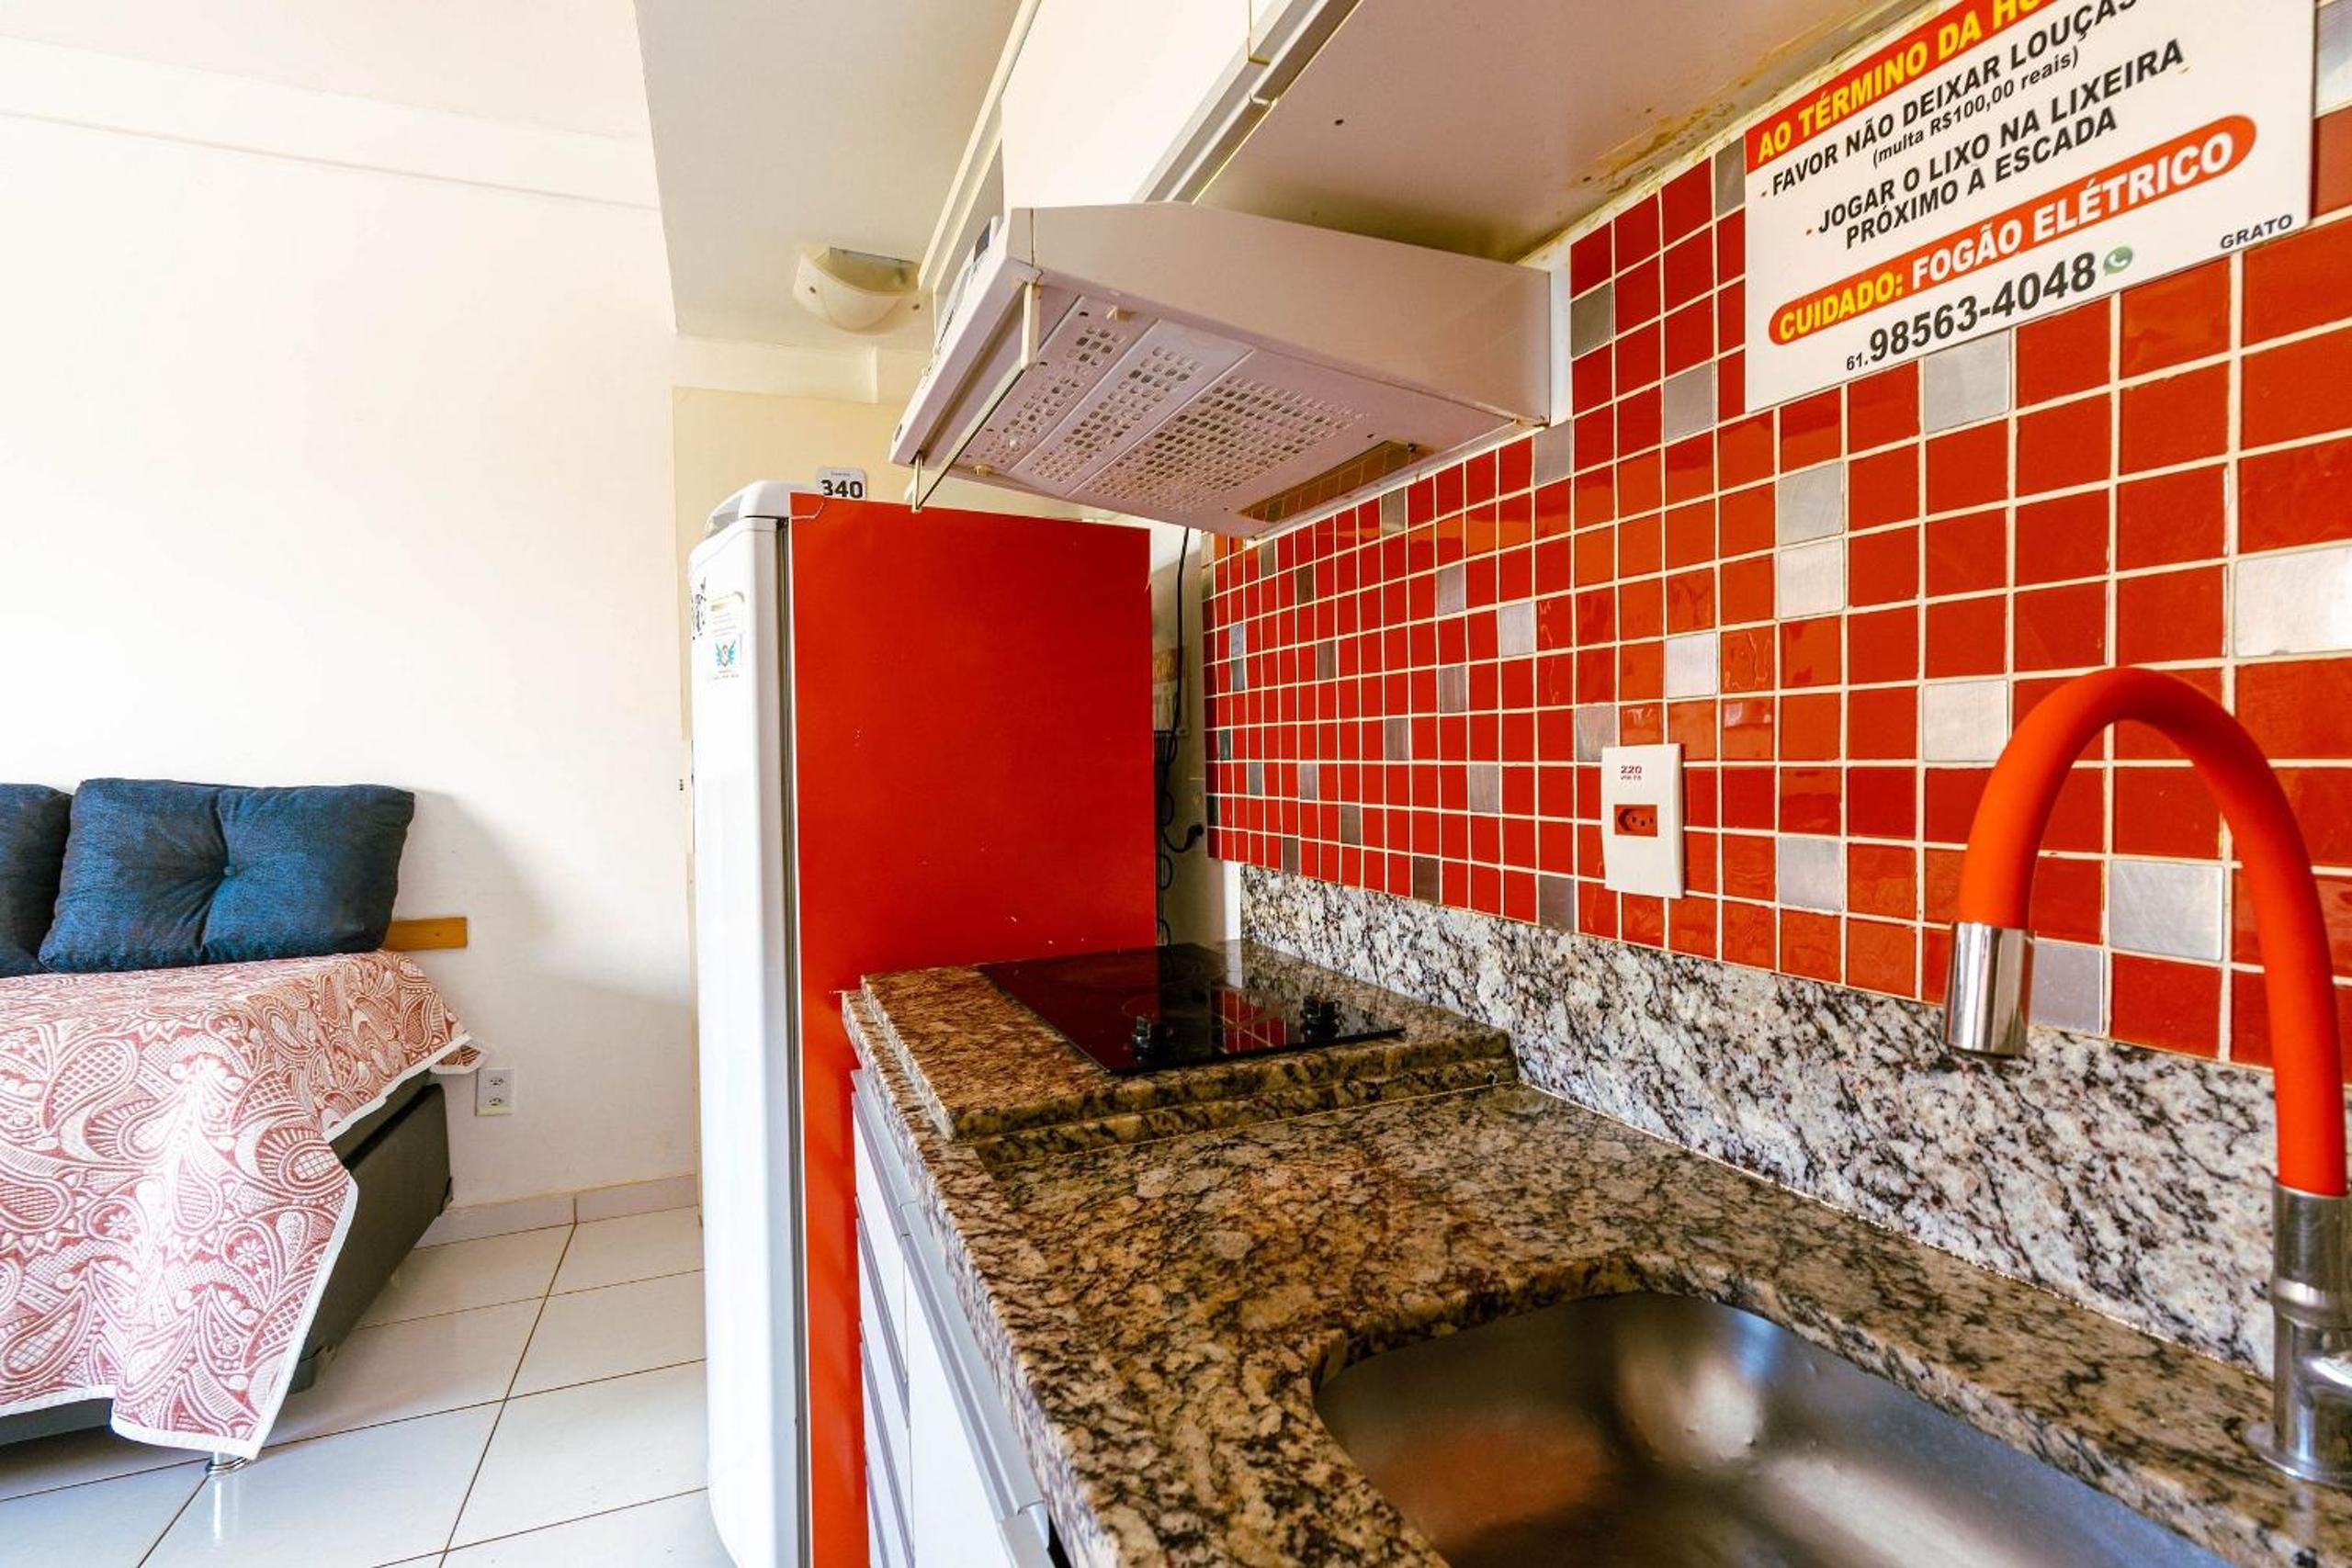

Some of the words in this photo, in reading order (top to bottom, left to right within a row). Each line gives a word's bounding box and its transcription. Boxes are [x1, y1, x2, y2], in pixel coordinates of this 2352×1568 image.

[1757, 121, 1792, 164] AO
[1798, 41, 1928, 138] TÉRMINO
[1938, 9, 1983, 61] DA
[1772, 143, 1838, 197] FAVOR
[1846, 114, 1894, 157] NÃO
[1903, 55, 2001, 127] DEIXAR
[1818, 179, 1895, 233] JOGAR
[1904, 167, 1920, 192] O
[1929, 133, 1991, 182] LIXO
[2000, 109, 2041, 149] NA
[2051, 39, 2185, 125] LIXEIRA
[1872, 129, 1925, 170] (multa
[1929, 79, 2015, 137] R$100,00
[2021, 45, 2079, 91] reais)
[1779, 271, 1904, 341] CUIDADO:
[1911, 220, 2022, 290] FOGÃO
[2033, 131, 2234, 243] ELÉTRICO
[1847, 179, 1959, 250] PRÓXIMO
[1996, 107, 2118, 183] ESCADA
[2220, 214, 2293, 250] GRATO
[820, 479, 864, 499] 340
[1621, 764, 1643, 774] 220
